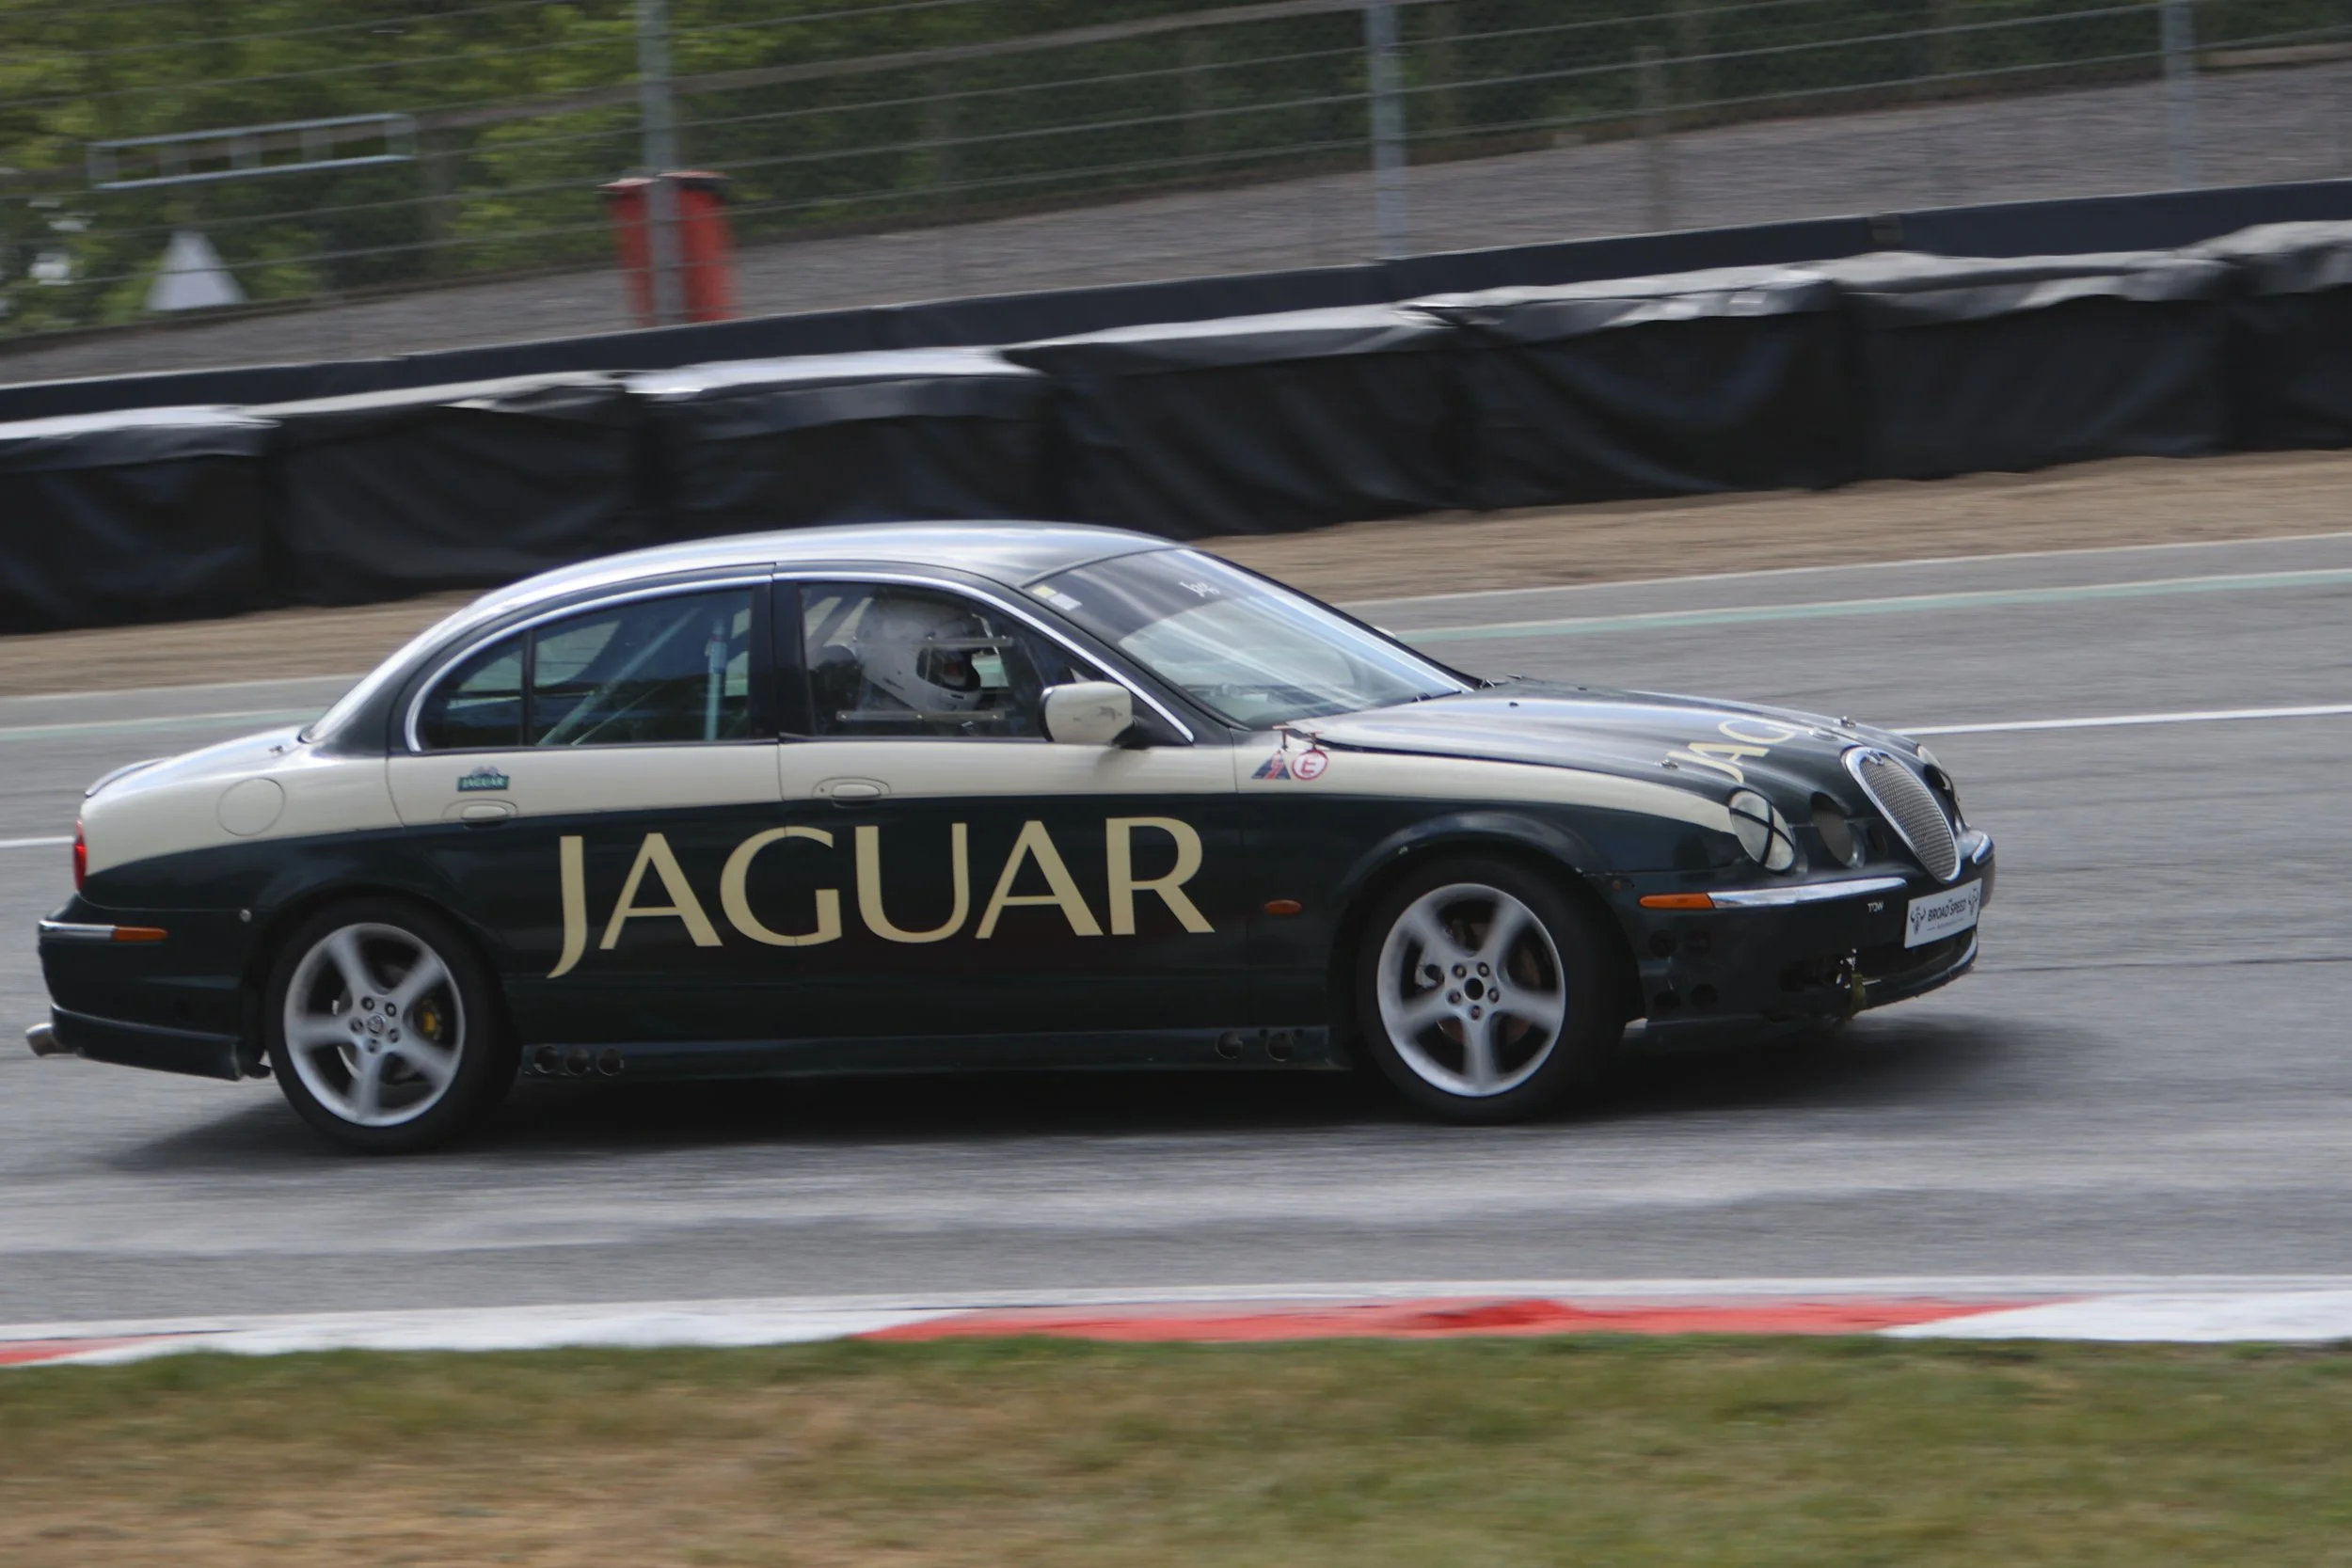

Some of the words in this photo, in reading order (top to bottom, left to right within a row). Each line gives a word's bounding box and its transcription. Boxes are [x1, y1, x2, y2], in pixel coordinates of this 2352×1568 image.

[1301, 760, 1316, 773] E
[461, 777, 505, 788] JAGUAR
[547, 816, 1215, 978] JAGUAR
[1867, 901, 1884, 913] TOW
[1928, 905, 1949, 922] BROAD
[1949, 899, 1967, 916] SPEED
